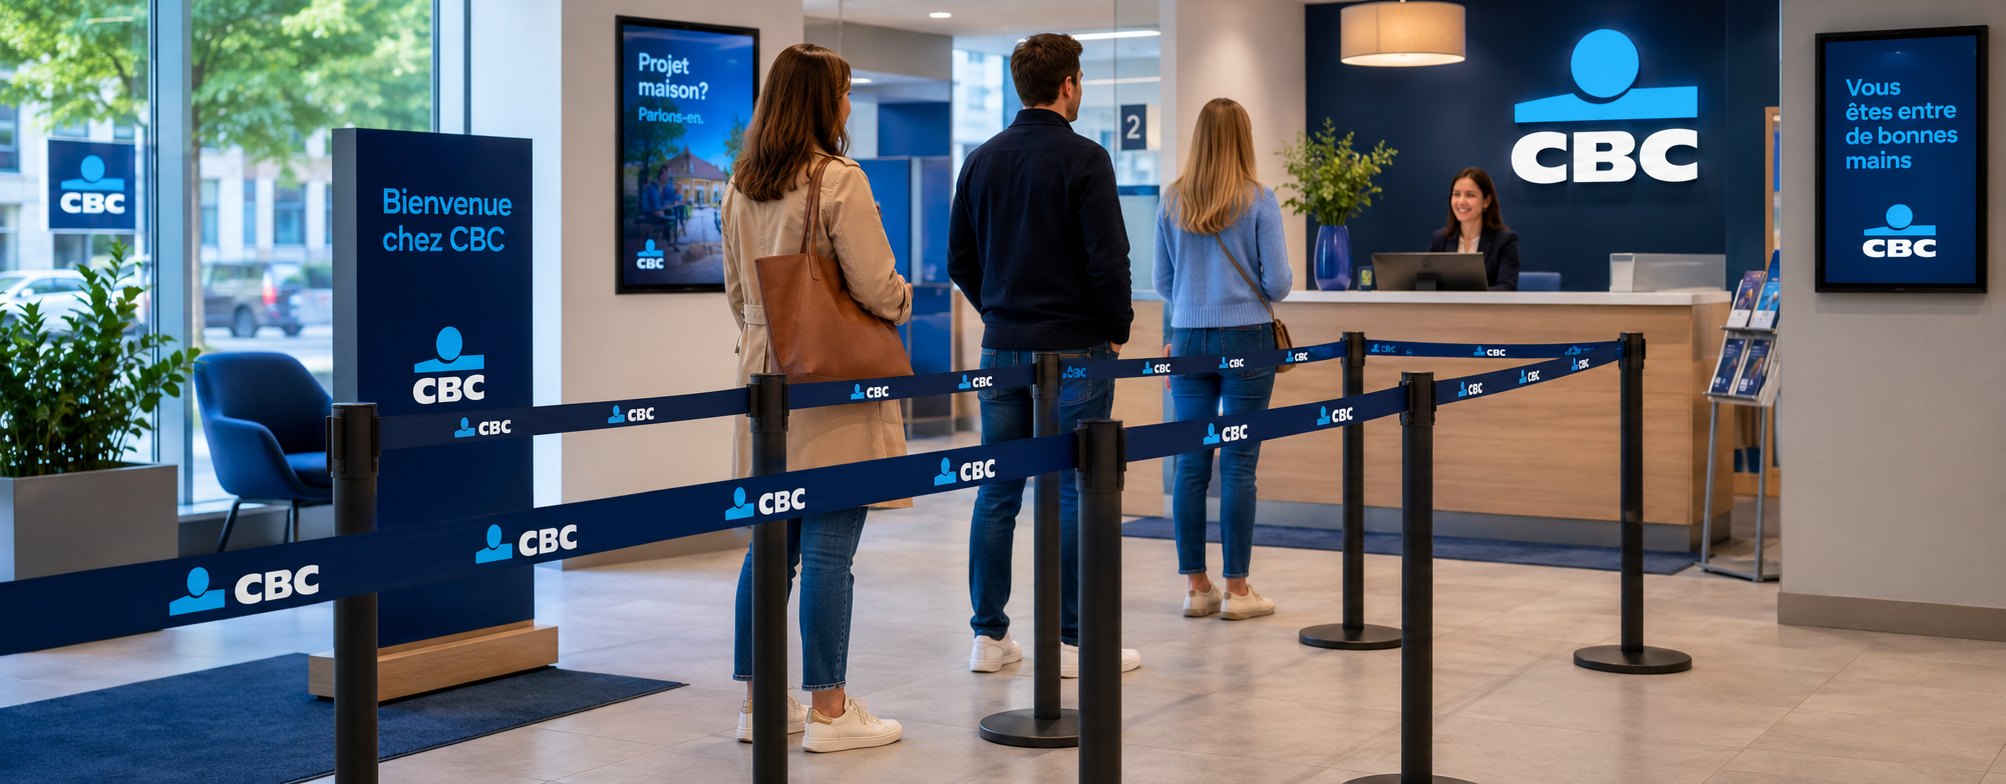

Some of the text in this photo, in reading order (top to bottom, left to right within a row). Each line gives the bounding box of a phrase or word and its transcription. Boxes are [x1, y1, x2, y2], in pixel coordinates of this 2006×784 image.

[639, 53, 689, 79] Projet
[638, 80, 708, 101] maison?
[1846, 79, 1901, 96] Vous
[639, 107, 704, 125] Parlons-en.
[1845, 103, 1956, 121] êtes entre
[1127, 115, 1140, 139] 2
[1846, 127, 1958, 144] de bonnes
[1511, 129, 1697, 184] CBC
[1847, 151, 1911, 169] mains
[61, 192, 124, 214] CBC
[384, 188, 512, 216] Bienvenue
[383, 225, 504, 251] chez CBC
[1863, 239, 1936, 257] CBC
[637, 258, 664, 269] CBC
[1295, 352, 1308, 361] CBC
[1487, 349, 1506, 357] CBC
[1154, 363, 1171, 374] CBC
[1230, 359, 1244, 368] CBC
[973, 376, 992, 387] CBC
[1527, 370, 1540, 382] CBC
[413, 375, 484, 404] CBC
[866, 385, 889, 399] CBC
[1468, 382, 1483, 396] CBC
[627, 406, 655, 422] CBC
[1332, 407, 1353, 422] CBC
[479, 420, 511, 435] CBC
[1222, 425, 1247, 442] CBC
[960, 459, 995, 481] CBC
[759, 488, 805, 515] CBC
[518, 524, 578, 557] CBC
[234, 564, 320, 606] CBC
